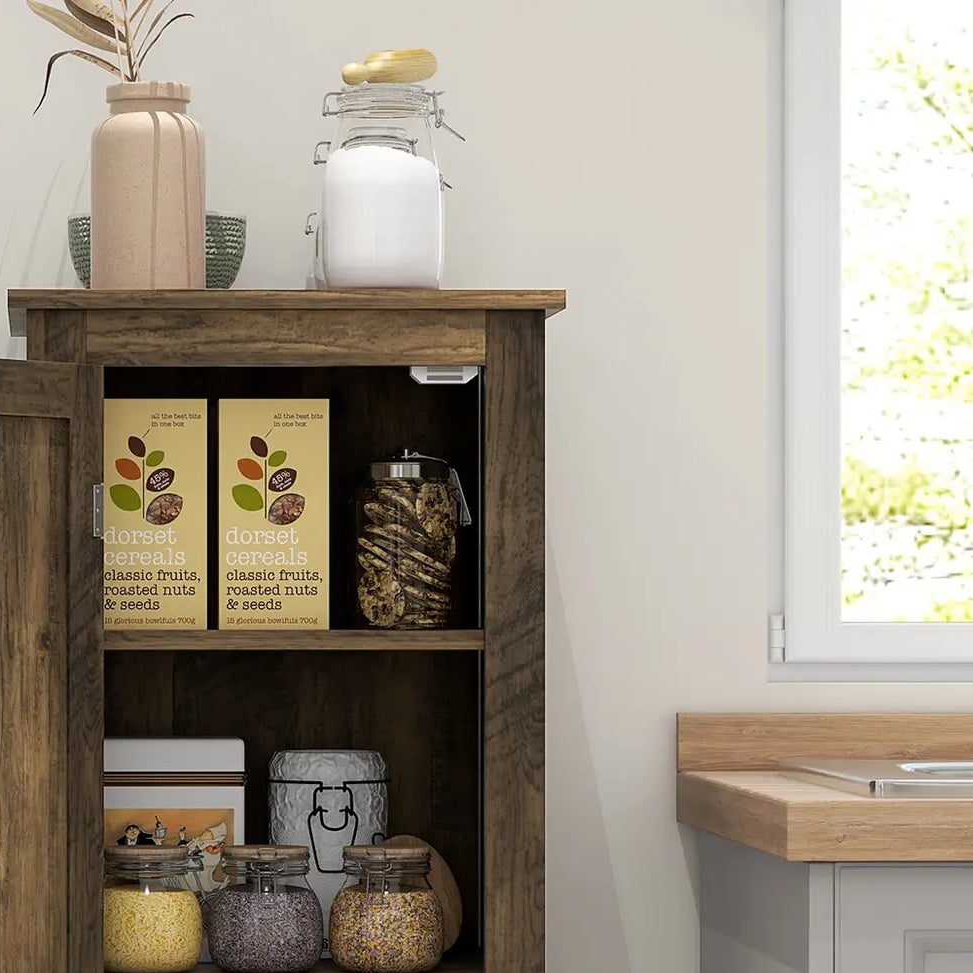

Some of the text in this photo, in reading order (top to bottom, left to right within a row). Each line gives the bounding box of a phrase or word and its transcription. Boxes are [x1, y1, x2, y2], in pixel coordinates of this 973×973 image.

[104, 526, 177, 545] dorset
[226, 526, 299, 545] dorset
[104, 547, 186, 566] cereals
[226, 547, 308, 566] cereals
[104, 569, 201, 583] classic fruits,
[226, 569, 323, 583] classic fruits,
[104, 584, 196, 596] roasted nuts
[226, 584, 318, 596] roasted nuts
[104, 598, 160, 610] & seeds
[226, 598, 282, 610] & seeds
[114, 617, 144, 625] glorious
[177, 617, 196, 625] 700g
[236, 617, 266, 625] glorious
[300, 617, 318, 625] 700g
